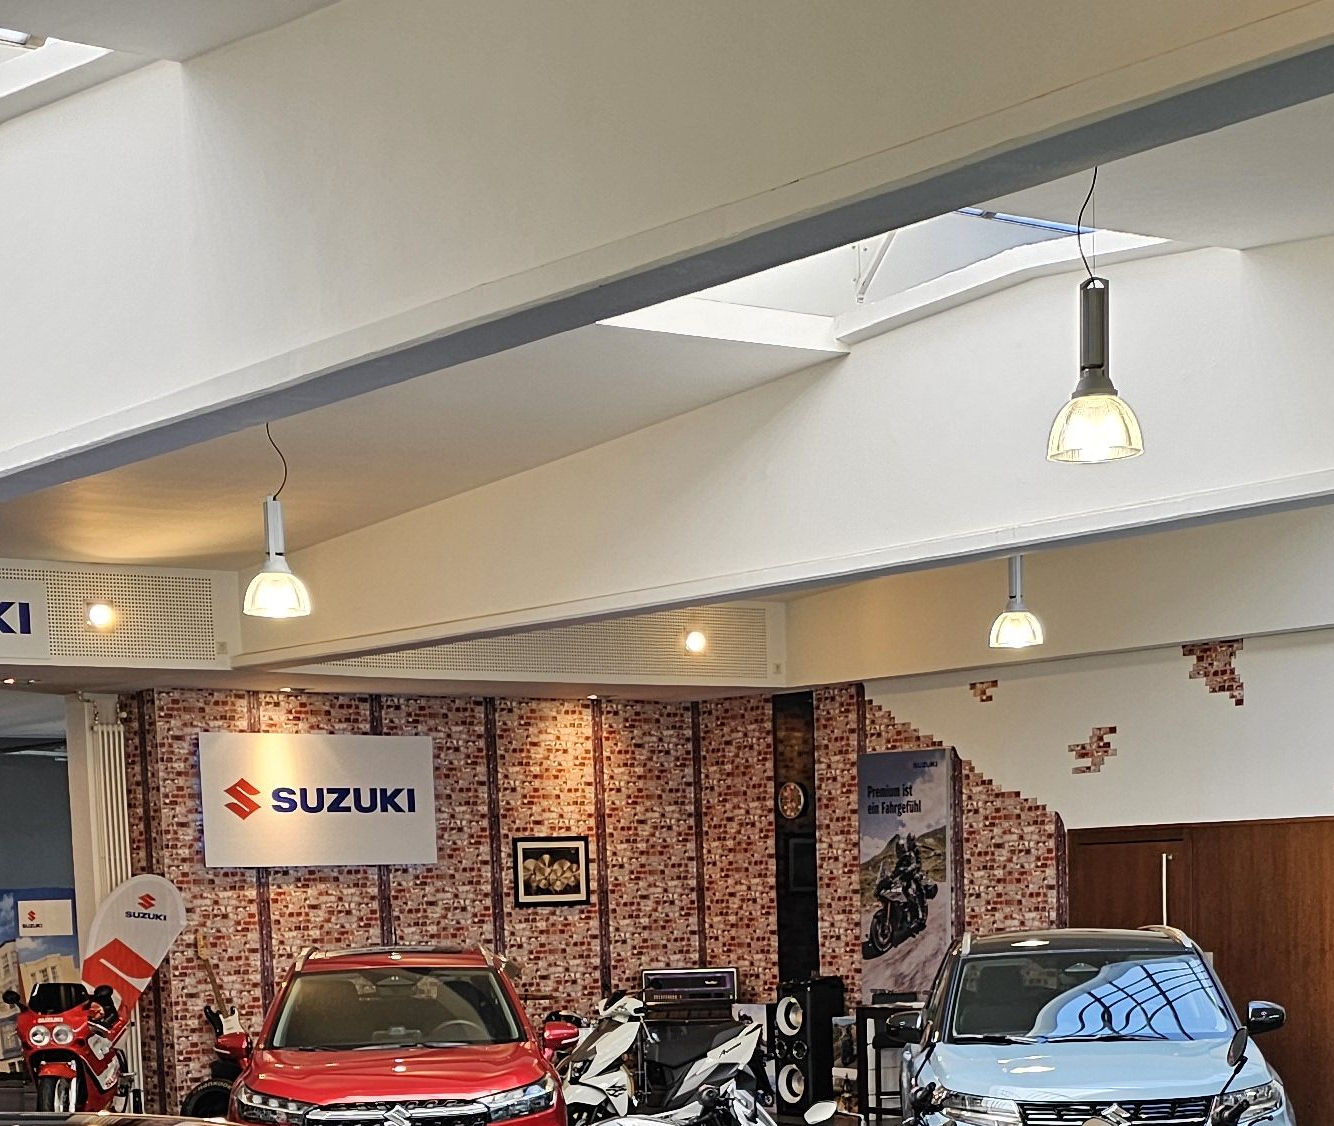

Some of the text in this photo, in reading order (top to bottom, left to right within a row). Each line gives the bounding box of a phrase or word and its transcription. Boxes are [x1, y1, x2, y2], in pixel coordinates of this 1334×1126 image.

[867, 783, 913, 798] Premium ist
[271, 787, 416, 814] SUZUKI
[867, 800, 922, 816] ein Fahrgefühl
[124, 911, 168, 922] SUZUKI
